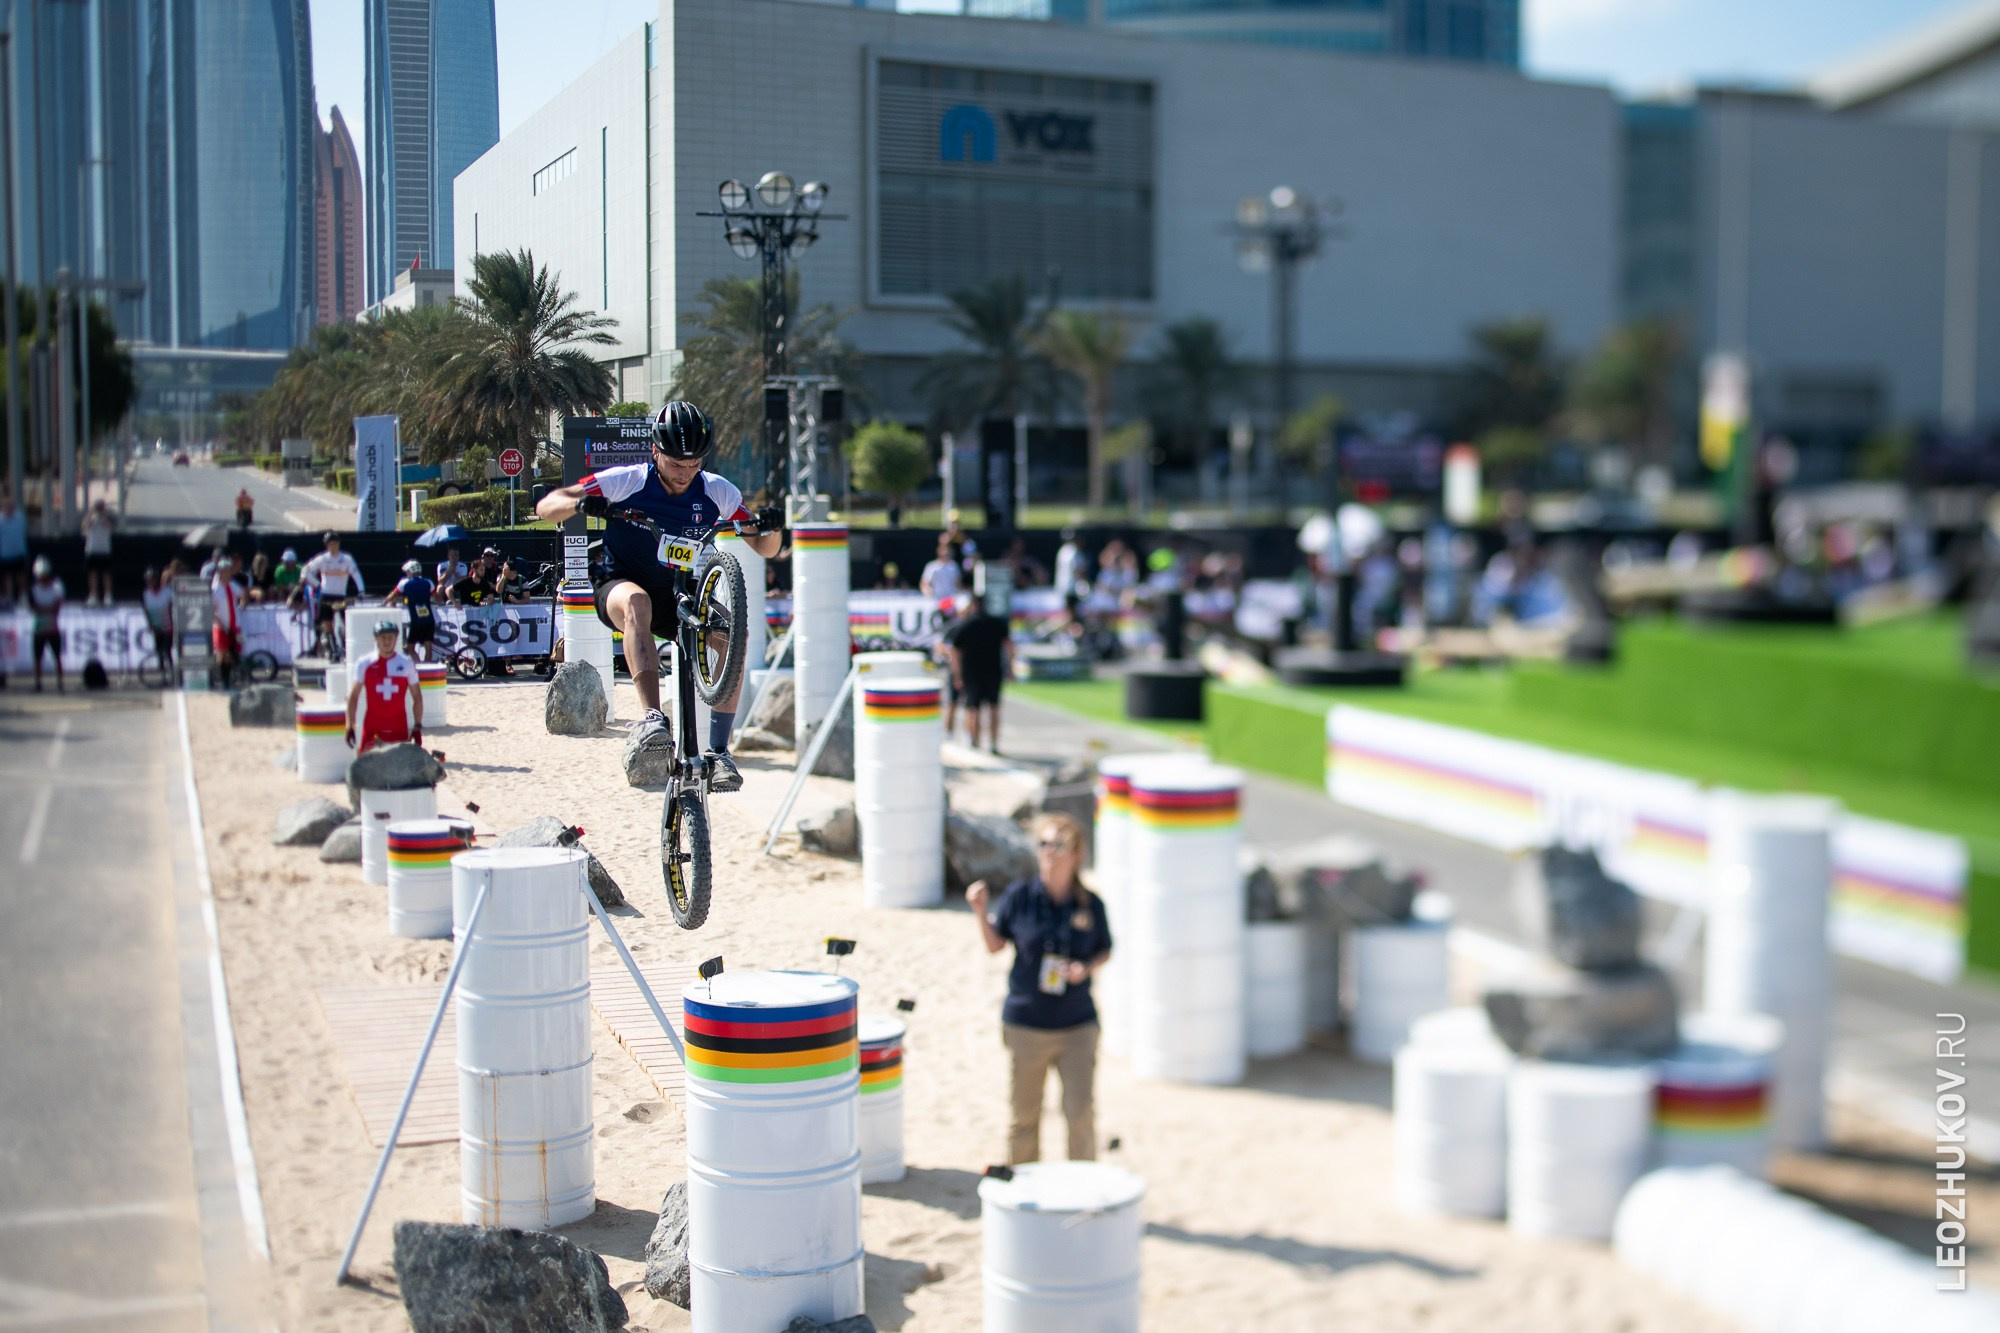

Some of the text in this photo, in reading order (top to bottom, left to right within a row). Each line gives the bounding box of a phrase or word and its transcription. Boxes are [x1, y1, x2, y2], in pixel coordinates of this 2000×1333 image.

[1005, 111, 1094, 151] VOX
[592, 442, 608, 451] 104
[503, 462, 520, 470] STOP
[365, 444, 377, 533] ike abu dhabi
[569, 537, 586, 545] UCI
[669, 546, 691, 562] 104
[186, 606, 203, 630] 2
[432, 617, 548, 648] SSOT
